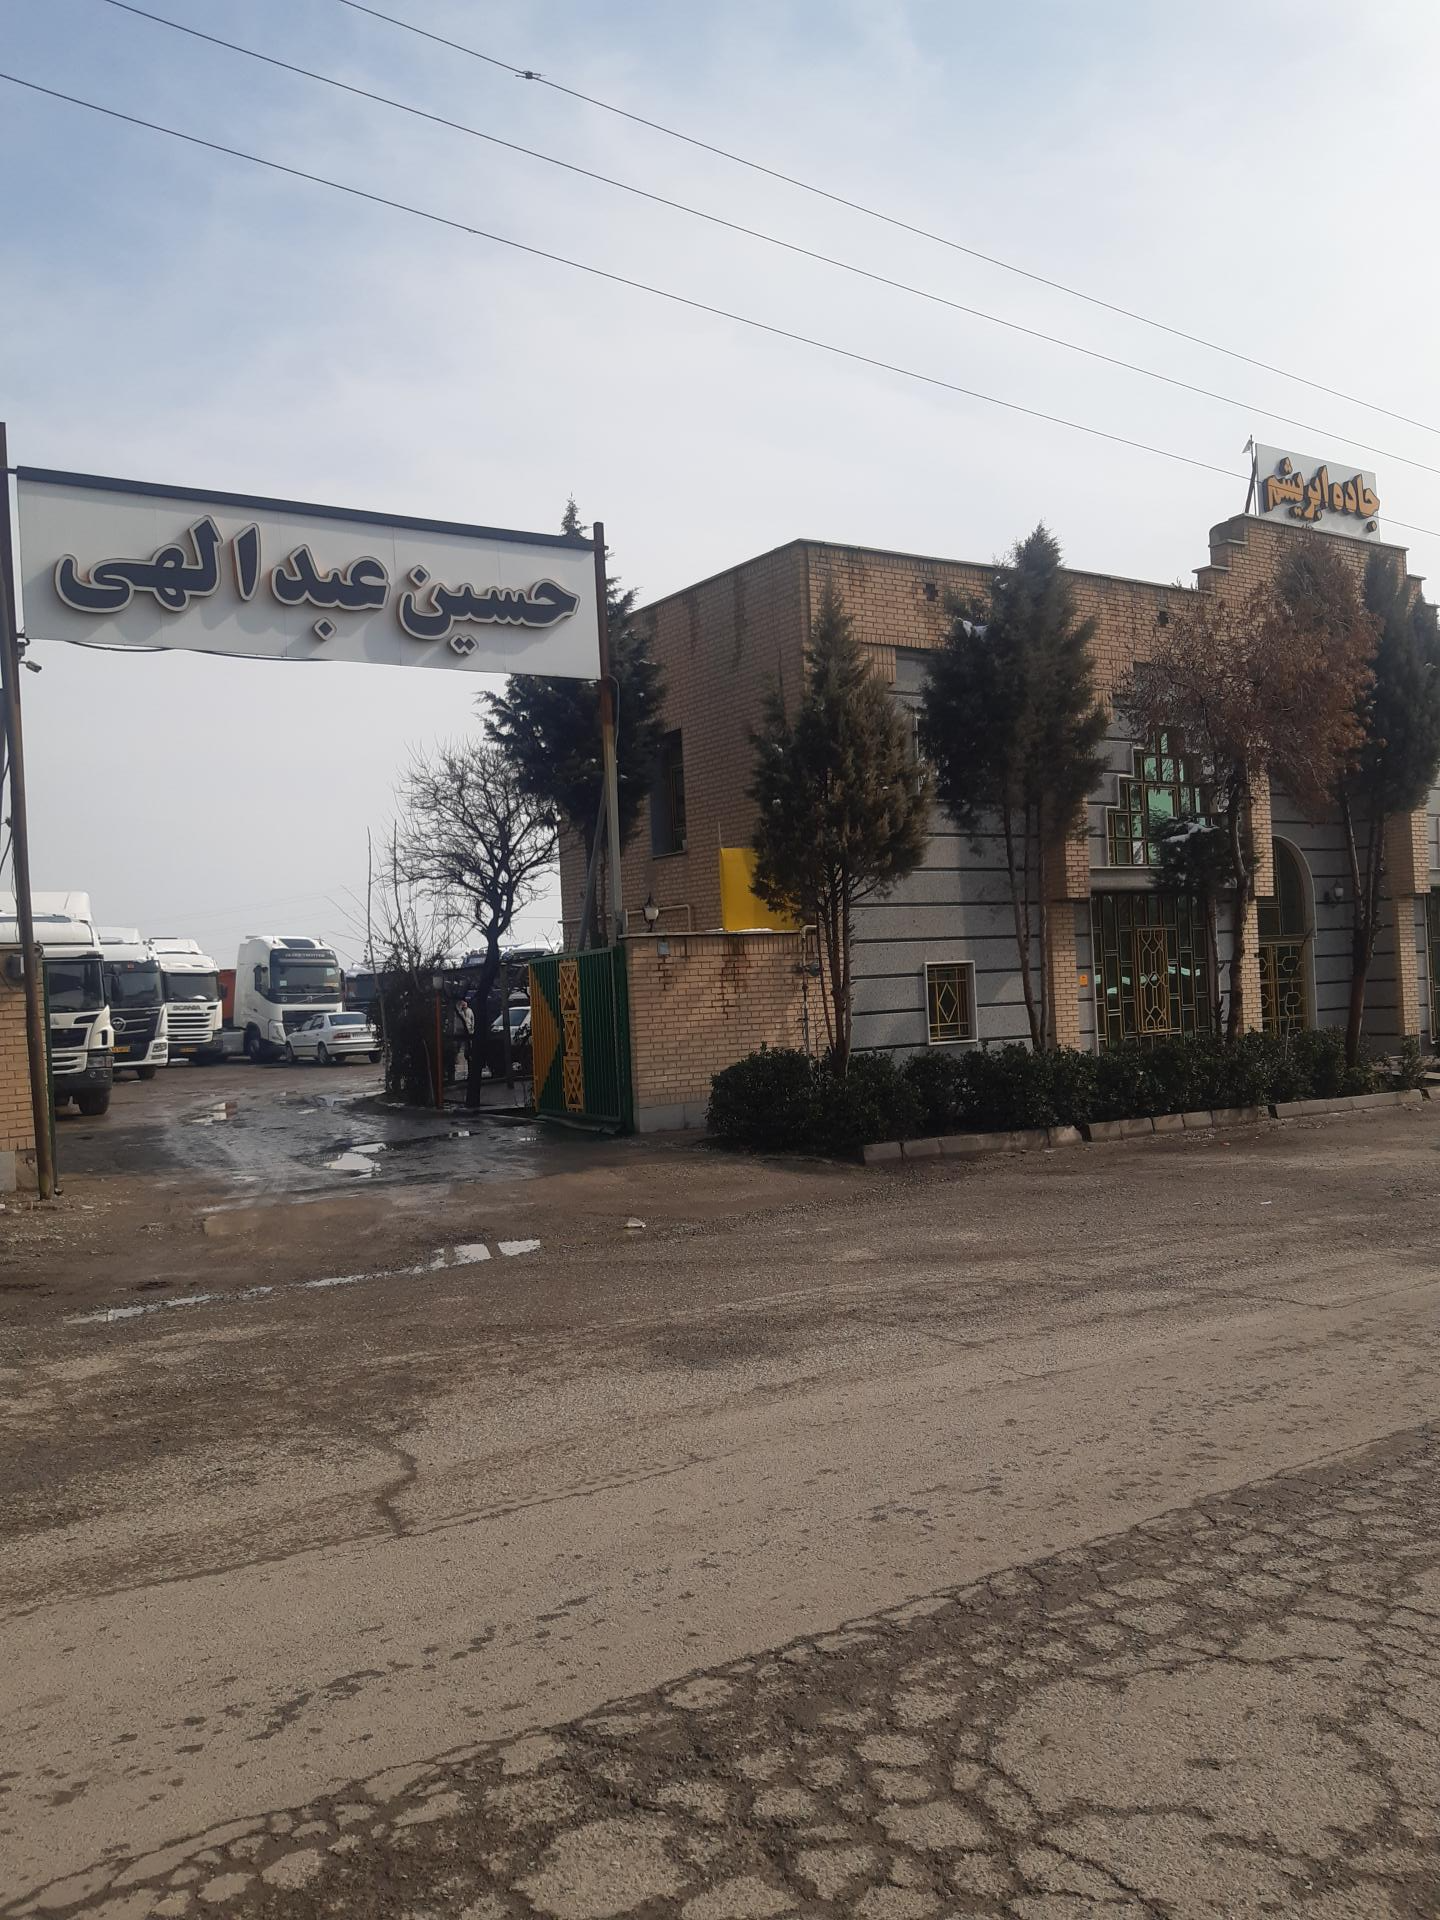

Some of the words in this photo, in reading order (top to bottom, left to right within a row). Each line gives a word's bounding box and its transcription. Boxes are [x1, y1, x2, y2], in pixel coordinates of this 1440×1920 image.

[1263, 457, 1329, 521] ابریشم
[1330, 474, 1380, 532] جاده
[398, 564, 580, 656] حسین
